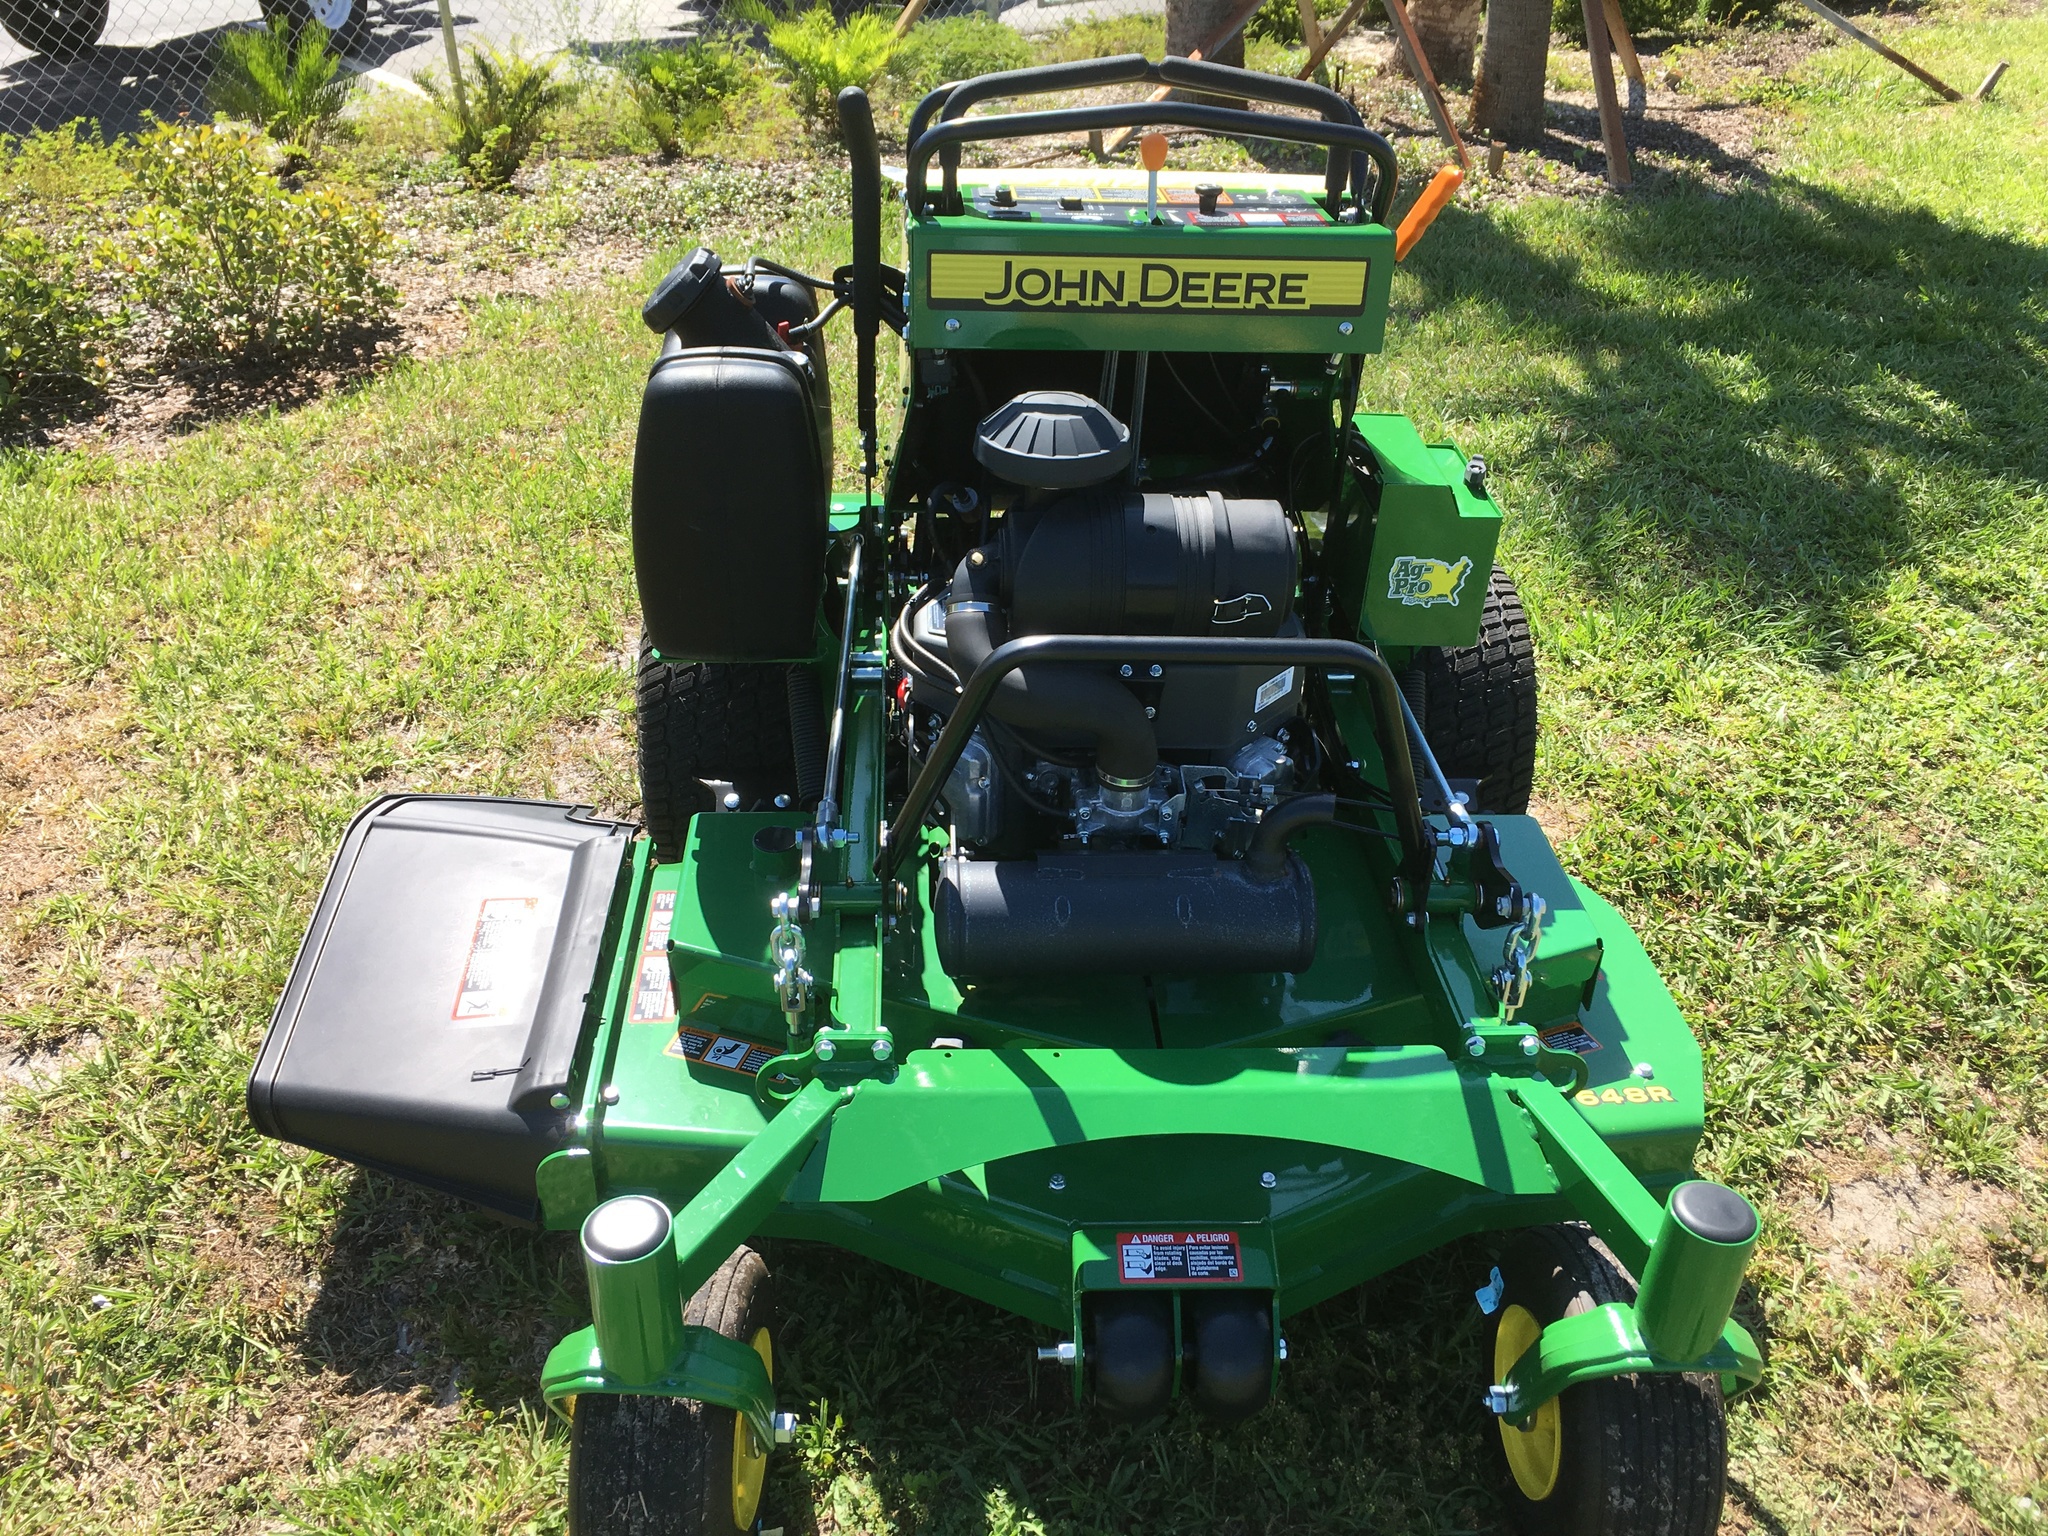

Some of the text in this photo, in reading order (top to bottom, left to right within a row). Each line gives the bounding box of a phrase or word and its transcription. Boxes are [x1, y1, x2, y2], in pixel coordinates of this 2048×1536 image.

[984, 260, 1309, 308] JOHN DEERE
[1394, 559, 1433, 580] Ag-
[1392, 578, 1431, 596] Pro
[1574, 1085, 1677, 1108] 648R
[1142, 1234, 1175, 1243] DANGER
[1196, 1233, 1230, 1243] PELIGRO
